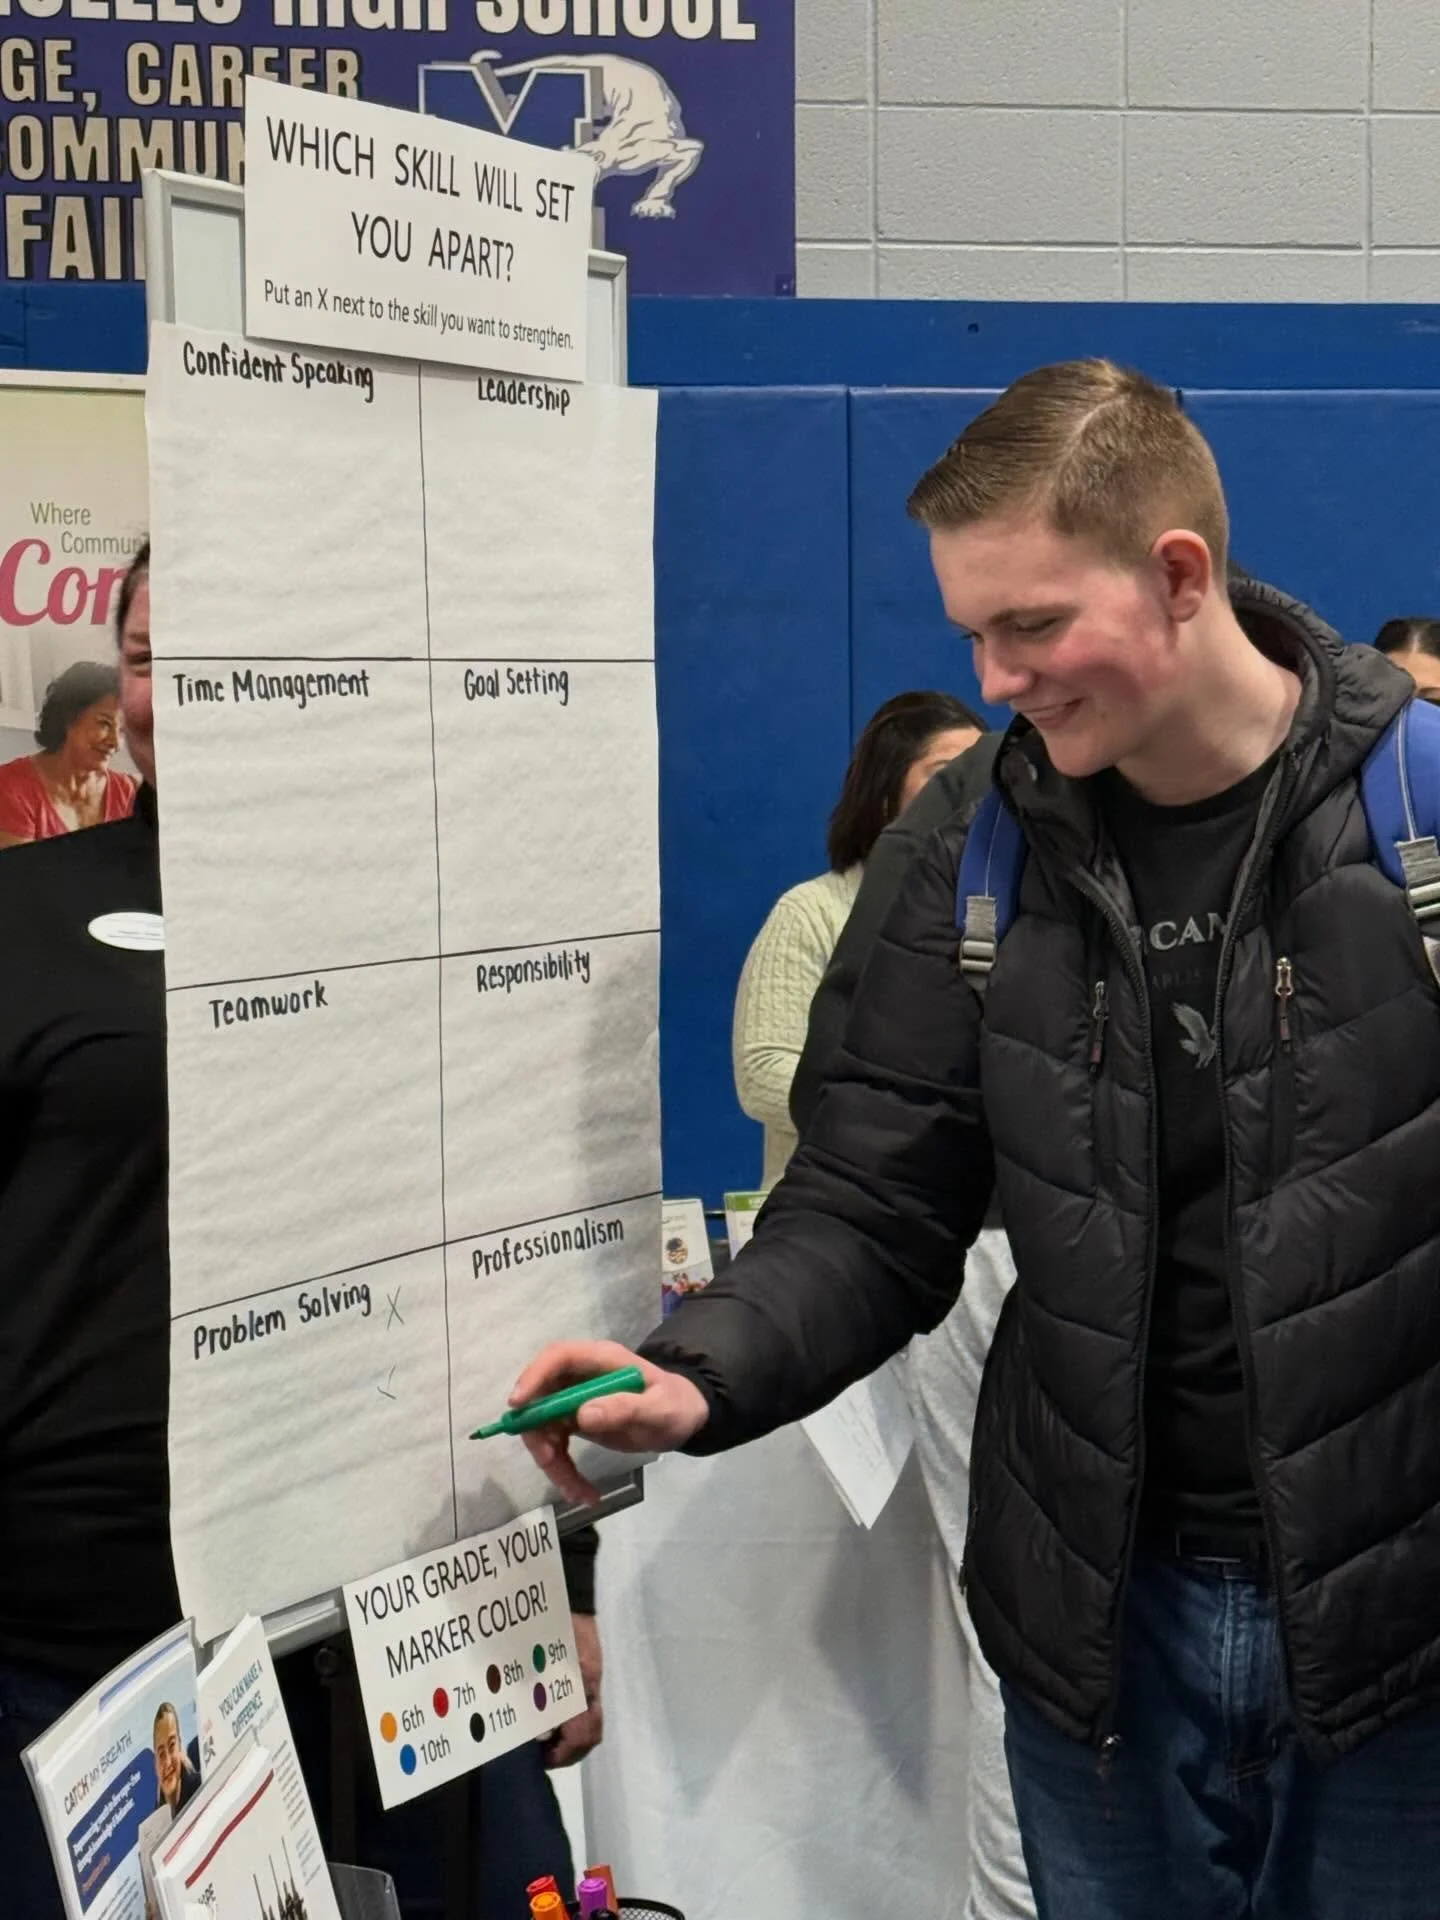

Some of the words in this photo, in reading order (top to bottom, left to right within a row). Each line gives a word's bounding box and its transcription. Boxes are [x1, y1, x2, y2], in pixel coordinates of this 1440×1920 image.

[266, 115, 374, 180] WHICH
[394, 143, 460, 198] SKILL
[474, 161, 522, 212] WILL
[535, 178, 575, 223] SET
[351, 211, 412, 263] YOU
[428, 227, 514, 283] APART?
[264, 279, 289, 306] Put
[294, 291, 312, 309] an
[317, 287, 329, 311] X
[333, 297, 364, 318] next
[369, 298, 383, 319] to
[388, 298, 409, 323] the
[413, 301, 437, 328] skill
[440, 313, 463, 335] you
[467, 315, 495, 338] want
[498, 319, 510, 340] to
[513, 322, 574, 351] strengthen.
[182, 340, 286, 384] Confident
[291, 352, 374, 403] Speaking
[477, 376, 571, 416] Leadership
[30, 501, 91, 526] Where
[172, 673, 225, 706] Time
[232, 669, 369, 710] Management
[464, 668, 500, 701] Goal
[506, 667, 569, 707] Setting
[209, 980, 329, 1029] Teamwork
[476, 949, 591, 994] Responsibility
[472, 1218, 625, 1280] Professionalism
[193, 1308, 286, 1361] Problem
[298, 1282, 372, 1324] Solving
[355, 1574, 421, 1626] YOUR
[422, 1544, 498, 1599] GRADE,
[498, 1521, 553, 1568] YOUR
[386, 1613, 475, 1679] MARKER
[477, 1581, 549, 1639] COLOR!
[402, 1705, 425, 1733] 6th
[453, 1682, 476, 1709] 7th
[503, 1660, 524, 1686] 8th
[548, 1639, 568, 1665] 9th
[420, 1735, 451, 1766] 10th
[489, 1704, 517, 1734] 11th
[549, 1676, 574, 1704] 12th
[64, 1776, 90, 1815] CATCH
[99, 1730, 132, 1774] BREATH
